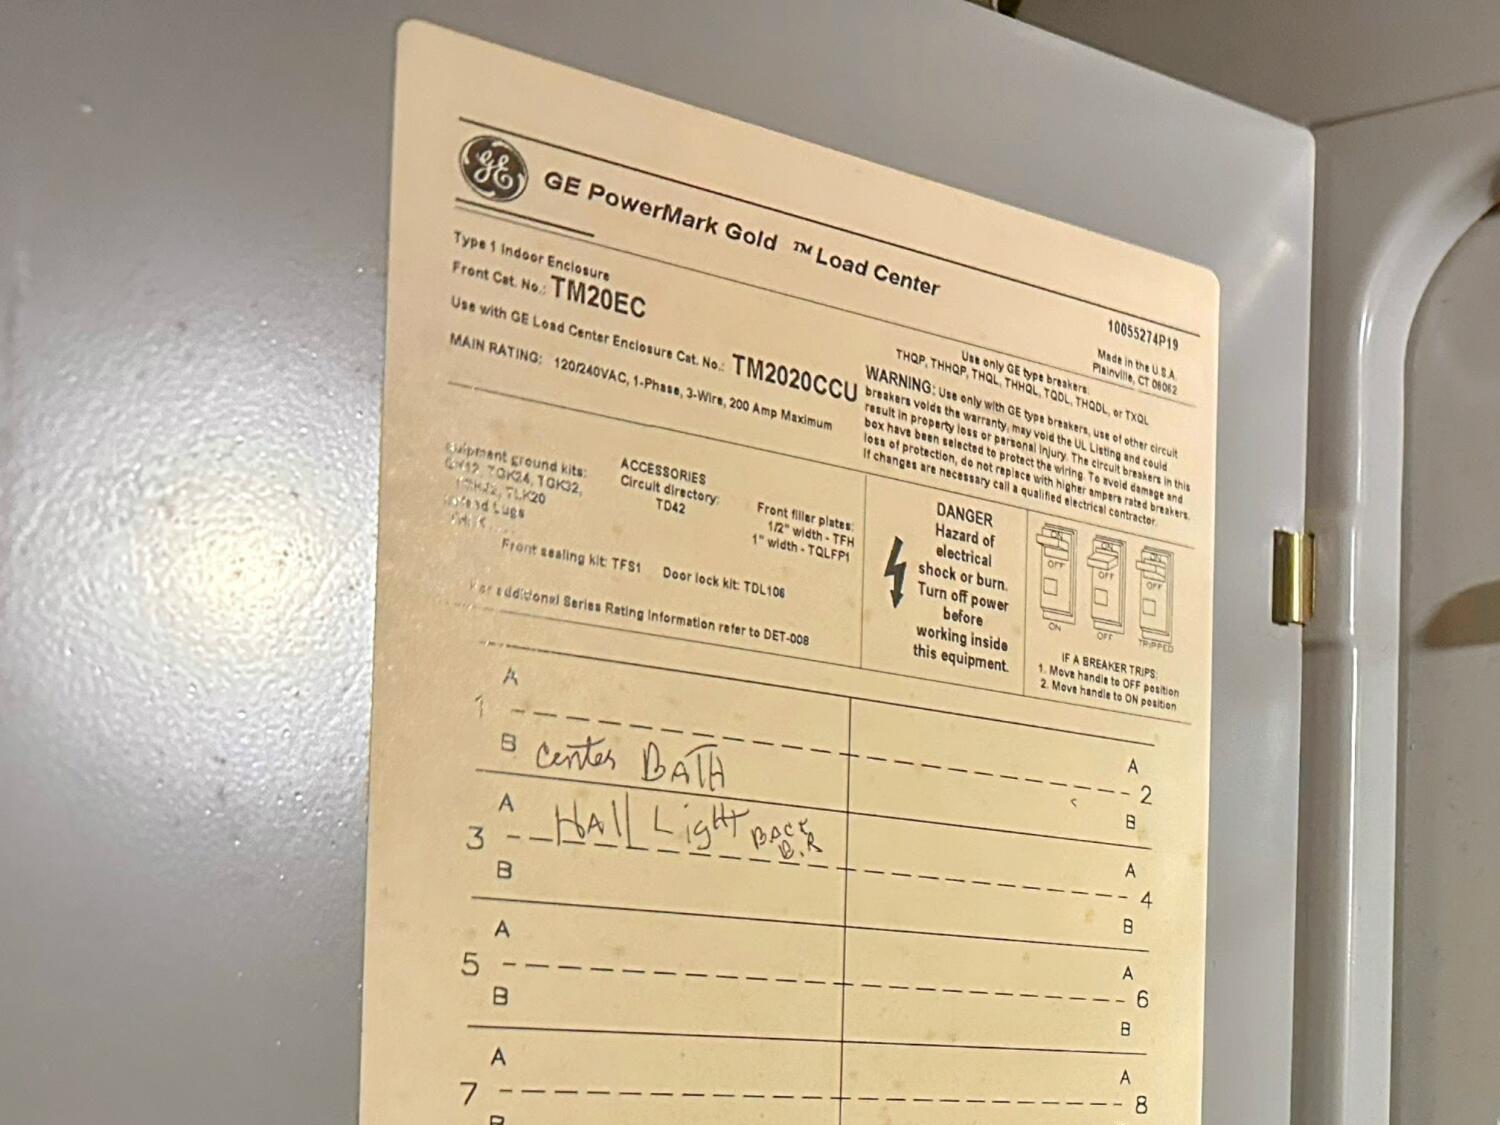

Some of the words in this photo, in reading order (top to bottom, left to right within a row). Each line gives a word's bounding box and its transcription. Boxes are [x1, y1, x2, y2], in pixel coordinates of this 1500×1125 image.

[544, 172, 581, 196] GE
[588, 184, 718, 235] PowerMark
[725, 223, 778, 251] Gold
[816, 247, 869, 276] Load
[874, 264, 939, 296] Center
[454, 231, 486, 250] Type
[491, 240, 495, 252] 1
[501, 243, 544, 264] Indoor
[547, 255, 609, 282] Enclosure
[453, 260, 489, 280] Front
[551, 275, 645, 318] TM20EC
[451, 296, 475, 312] Use
[480, 305, 506, 319] with
[511, 310, 529, 325] GE
[533, 315, 564, 333] Load
[569, 324, 609, 344] Center
[613, 334, 672, 359] Enclosure
[677, 350, 699, 365] Cat.
[733, 353, 857, 402] TM2020CCU
[450, 333, 485, 351] MAIN
[489, 342, 542, 364] RATING:
[555, 357, 629, 386] 120/240VAC,
[634, 375, 683, 399] 1-Phase,
[687, 387, 726, 408] 3-Wire,
[730, 397, 749, 411] 200
[752, 402, 777, 419] Amp
[781, 408, 832, 430] Maximum
[866, 365, 936, 396] WARNING:
[621, 457, 706, 485] ACCESSORIES
[656, 497, 685, 514] TD42
[937, 502, 993, 528] DANGER
[936, 522, 979, 545] Hazard
[983, 534, 996, 548] of
[541, 548, 585, 566] sealing
[612, 557, 640, 573] TFS1
[936, 544, 991, 567] electrical
[663, 566, 692, 581] Door
[695, 572, 719, 587] lock
[744, 581, 785, 598] TDL106
[919, 561, 956, 581] shock
[960, 572, 973, 584] or
[918, 581, 947, 600] Turn
[951, 589, 968, 604] off
[971, 595, 1009, 612] power
[943, 606, 983, 627] before
[917, 626, 967, 648] working
[971, 632, 1008, 651] inside
[913, 644, 937, 659] this
[1141, 785, 1152, 805] 2
[466, 826, 484, 850] 3
[1141, 891, 1152, 909] 4
[461, 952, 479, 976] 5
[1137, 990, 1148, 1008] 6
[460, 1082, 477, 1105] 7
[1136, 1096, 1147, 1114] 8
